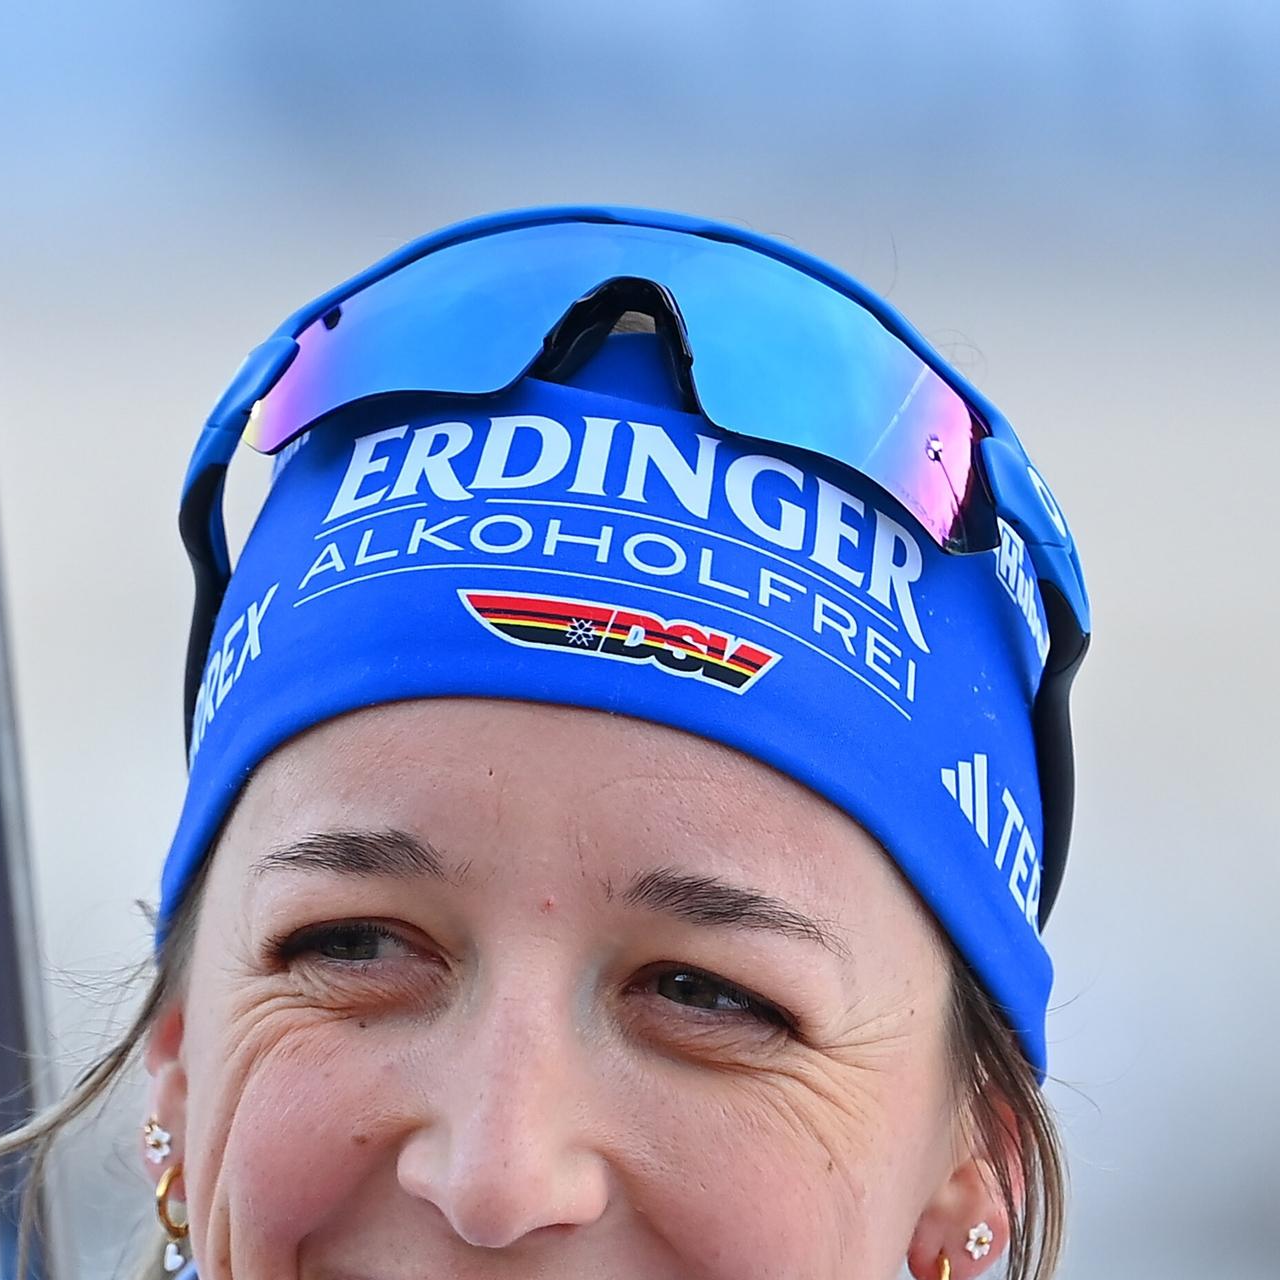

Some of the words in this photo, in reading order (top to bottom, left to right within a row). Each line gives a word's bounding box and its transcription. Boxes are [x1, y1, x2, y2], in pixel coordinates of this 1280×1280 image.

[298, 513, 915, 702] ALKOHOLFREI
[322, 415, 930, 653] ERDINGER
[600, 609, 776, 690] DSV
